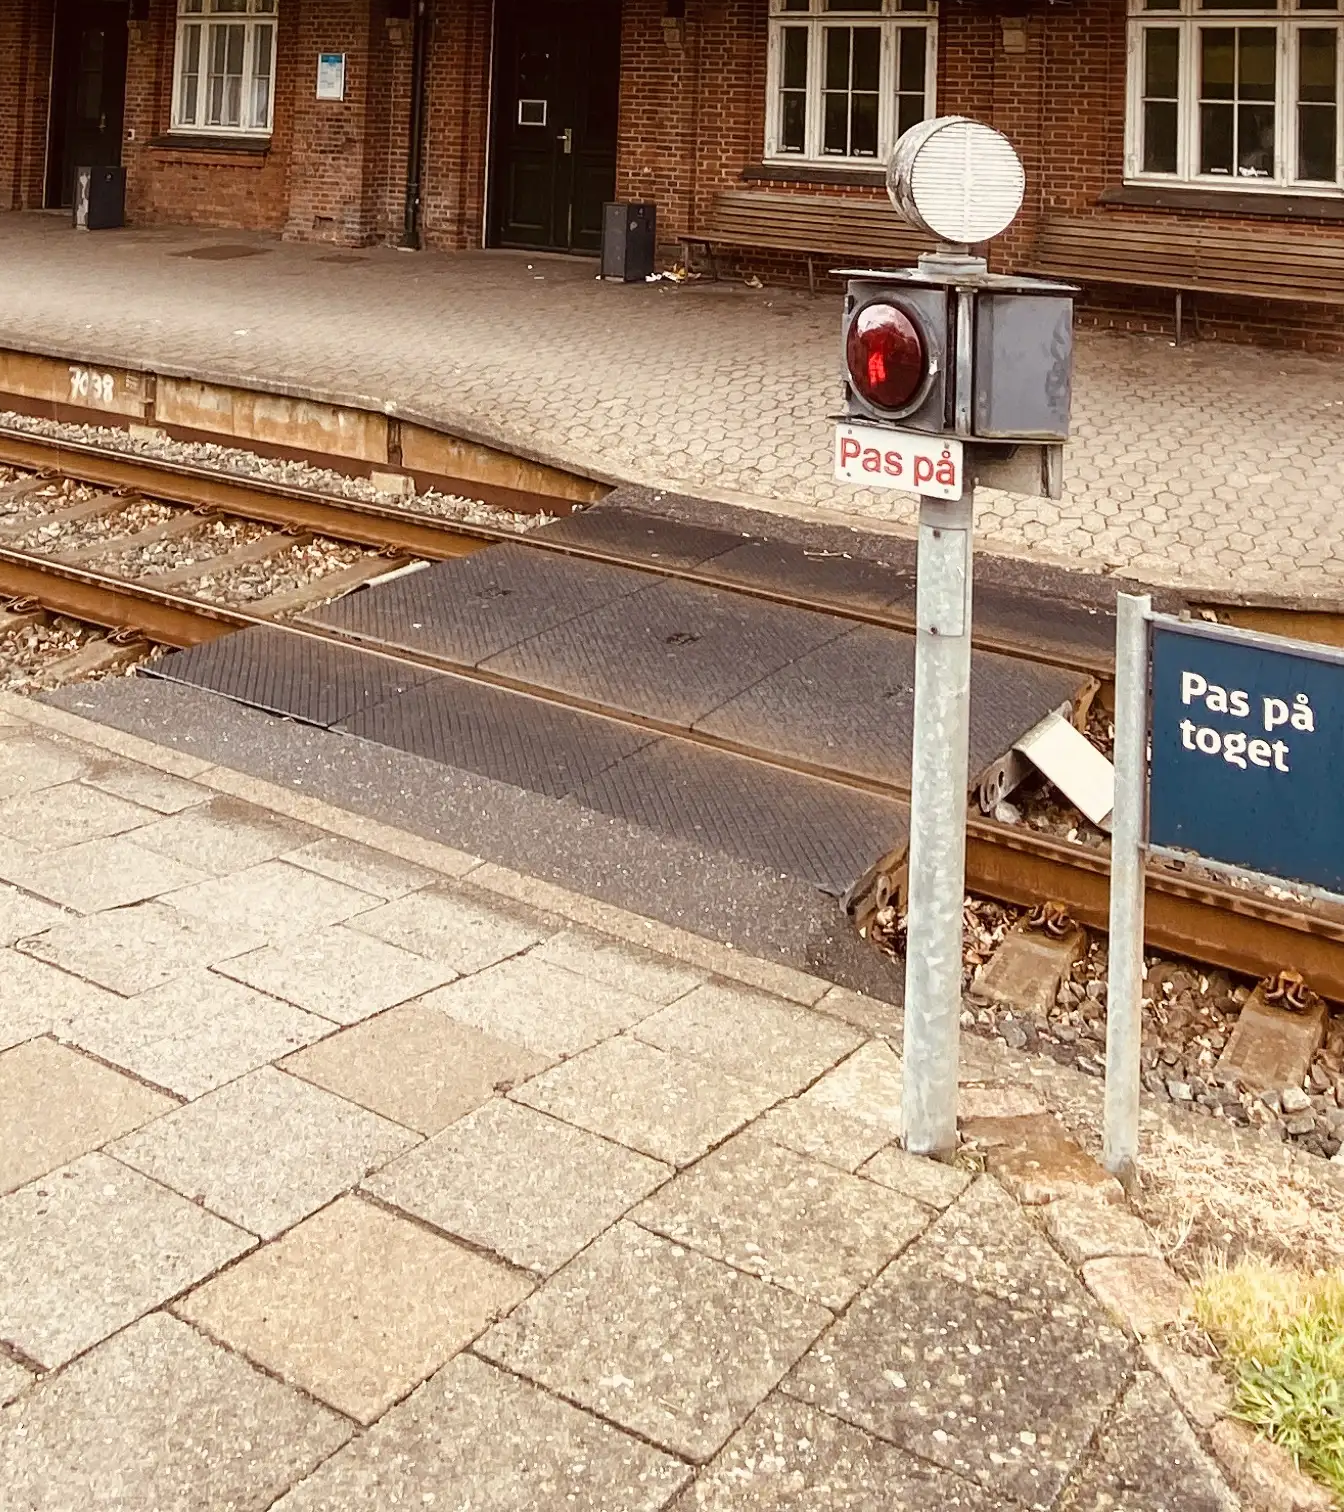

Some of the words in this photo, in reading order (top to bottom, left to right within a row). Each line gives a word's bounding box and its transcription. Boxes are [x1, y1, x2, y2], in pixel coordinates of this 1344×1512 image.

[840, 436, 904, 476] Pas
[912, 449, 957, 487] på
[1180, 670, 1251, 718] Pas
[1262, 691, 1316, 733] på
[1179, 718, 1291, 773] toget
